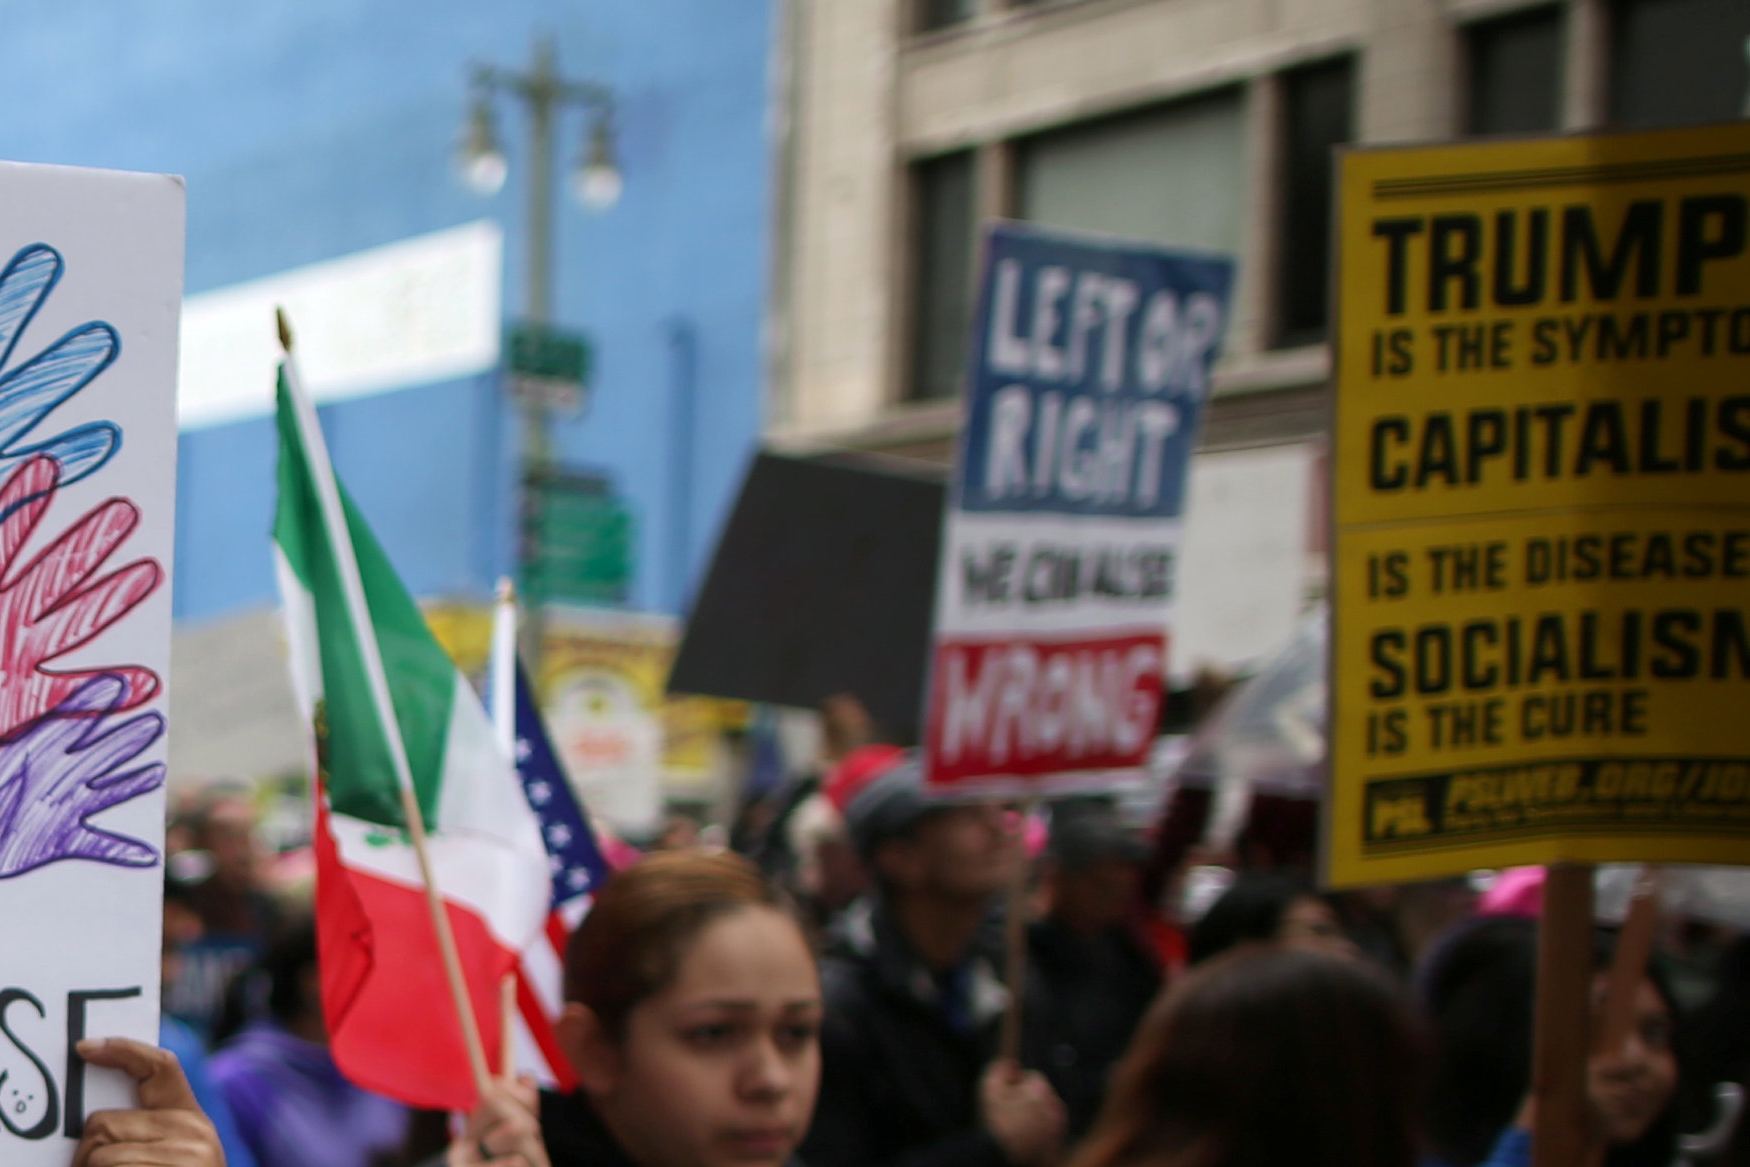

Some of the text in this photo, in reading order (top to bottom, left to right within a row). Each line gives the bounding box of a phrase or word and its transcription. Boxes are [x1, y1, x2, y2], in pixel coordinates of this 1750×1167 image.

[1372, 193, 1750, 317] TRUMP
[988, 257, 1220, 398] LEFT OR
[1372, 327, 1414, 379] IS
[1432, 319, 1514, 374] THE
[985, 384, 1181, 510] RIGHT
[1367, 530, 1750, 599] IS THE DISEASE
[940, 643, 1158, 768] WRONG
[1367, 687, 1650, 757] IS THE CURE
